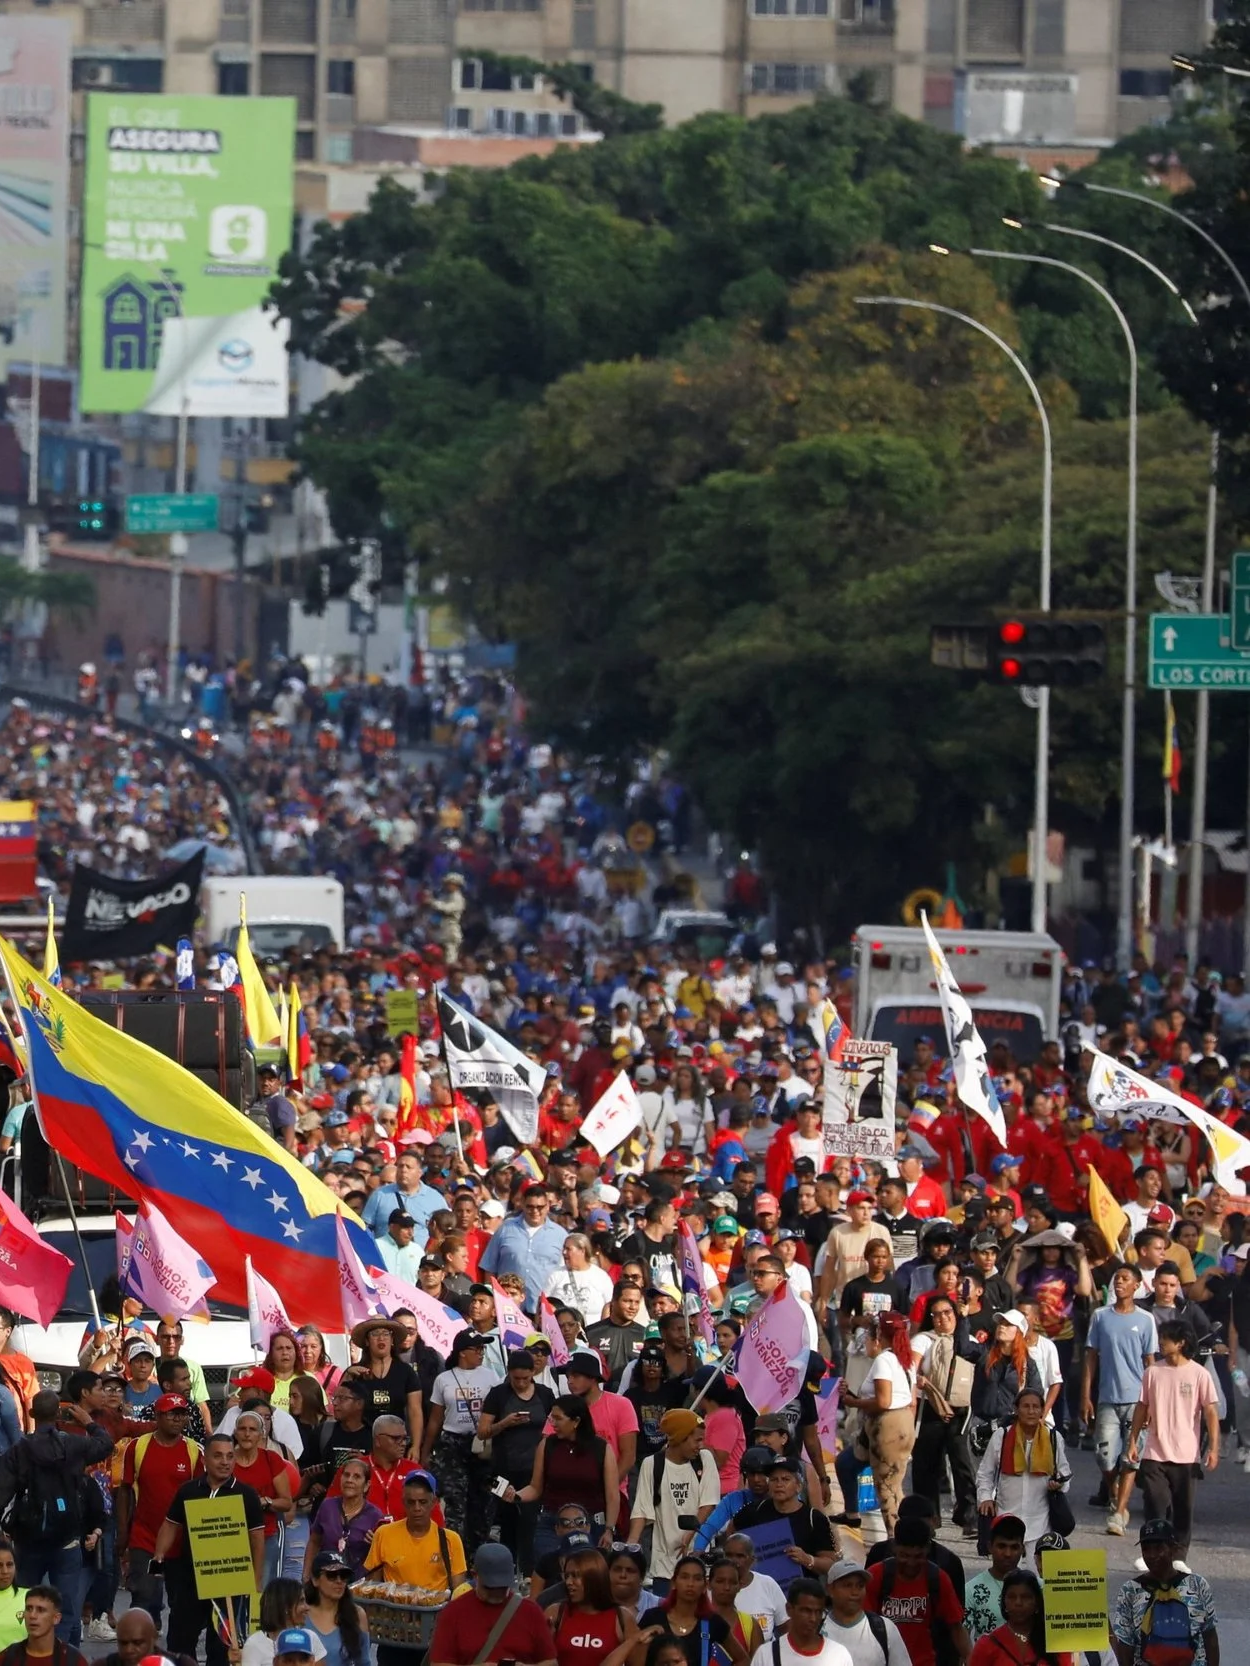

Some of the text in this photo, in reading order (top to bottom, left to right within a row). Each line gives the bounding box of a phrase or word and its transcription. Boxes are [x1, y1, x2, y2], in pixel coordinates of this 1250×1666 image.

[110, 129, 219, 152] ASEGURA
[109, 152, 221, 179] SU VILLA,
[107, 179, 184, 198] NUNCA
[106, 220, 186, 241] NI UNA
[1158, 667, 1194, 684] LOS
[895, 1008, 1024, 1031] AMBNCIA
[670, 1482, 690, 1491] DON'T
[673, 1491, 689, 1499] GIVE
[570, 1633, 603, 1648] alo
